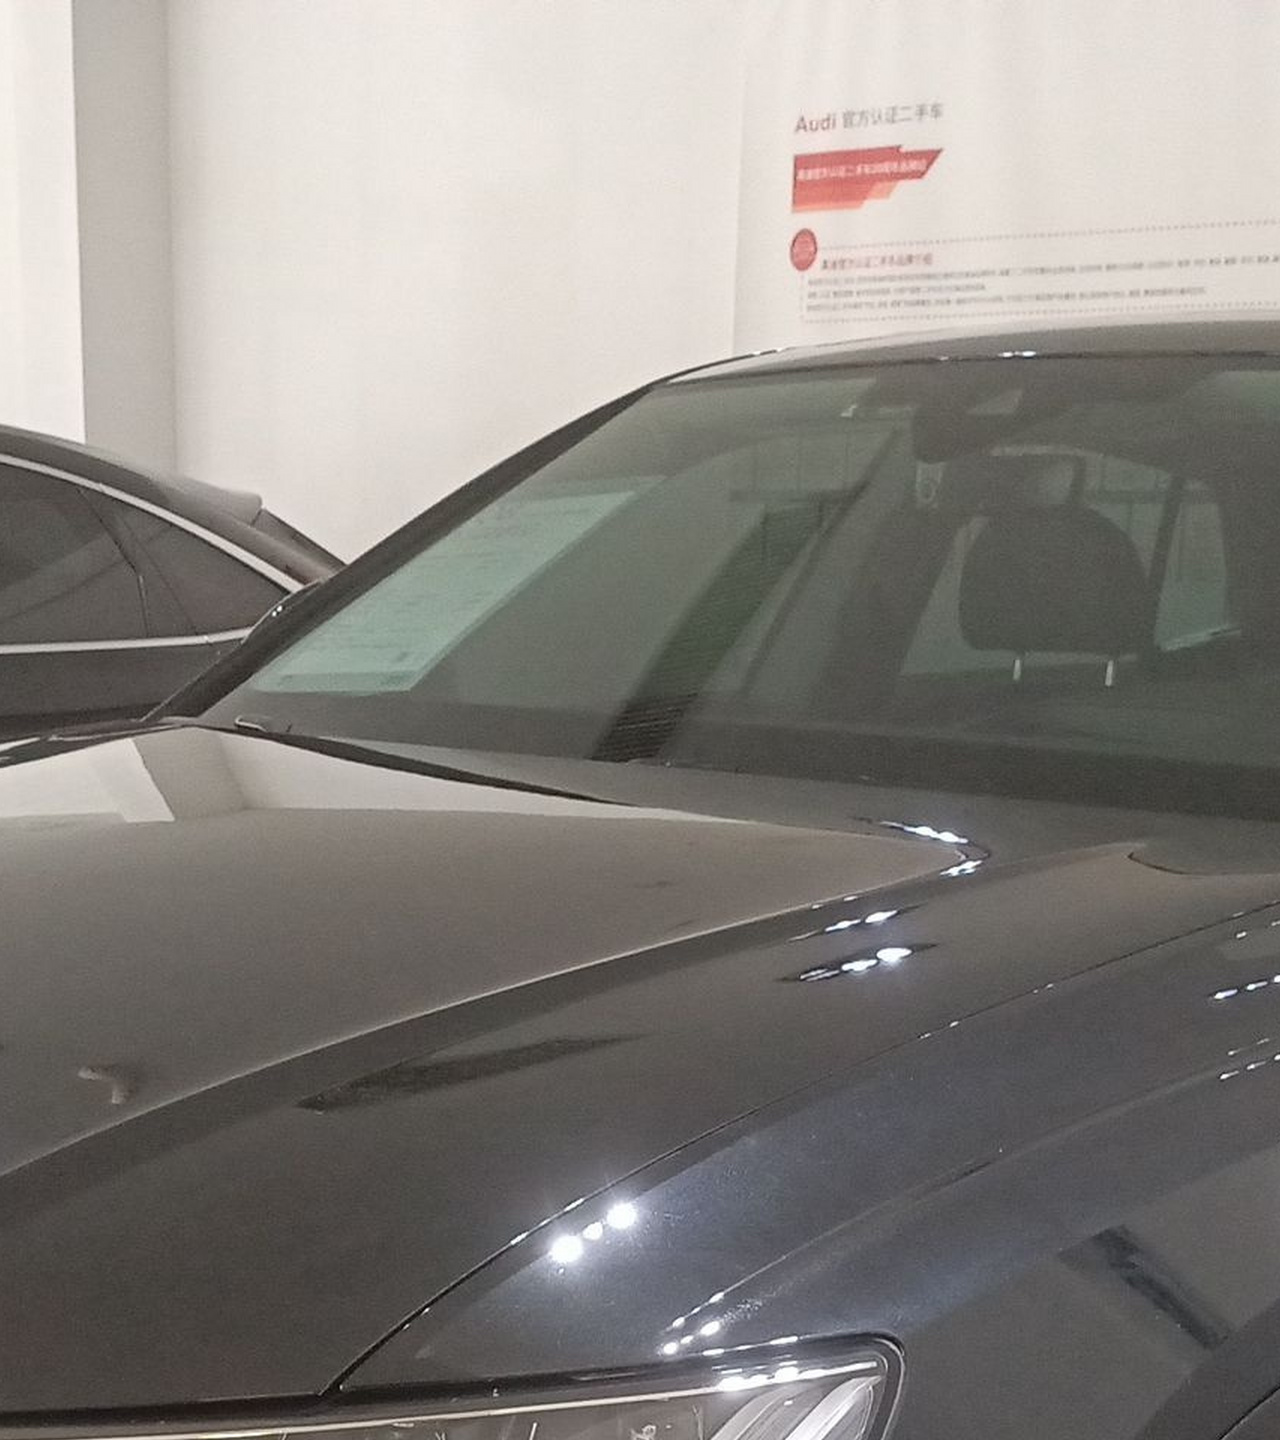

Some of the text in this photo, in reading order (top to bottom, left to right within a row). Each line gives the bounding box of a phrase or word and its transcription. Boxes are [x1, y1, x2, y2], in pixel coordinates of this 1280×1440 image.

[794, 103, 943, 133] Audi 官方认证二手车
